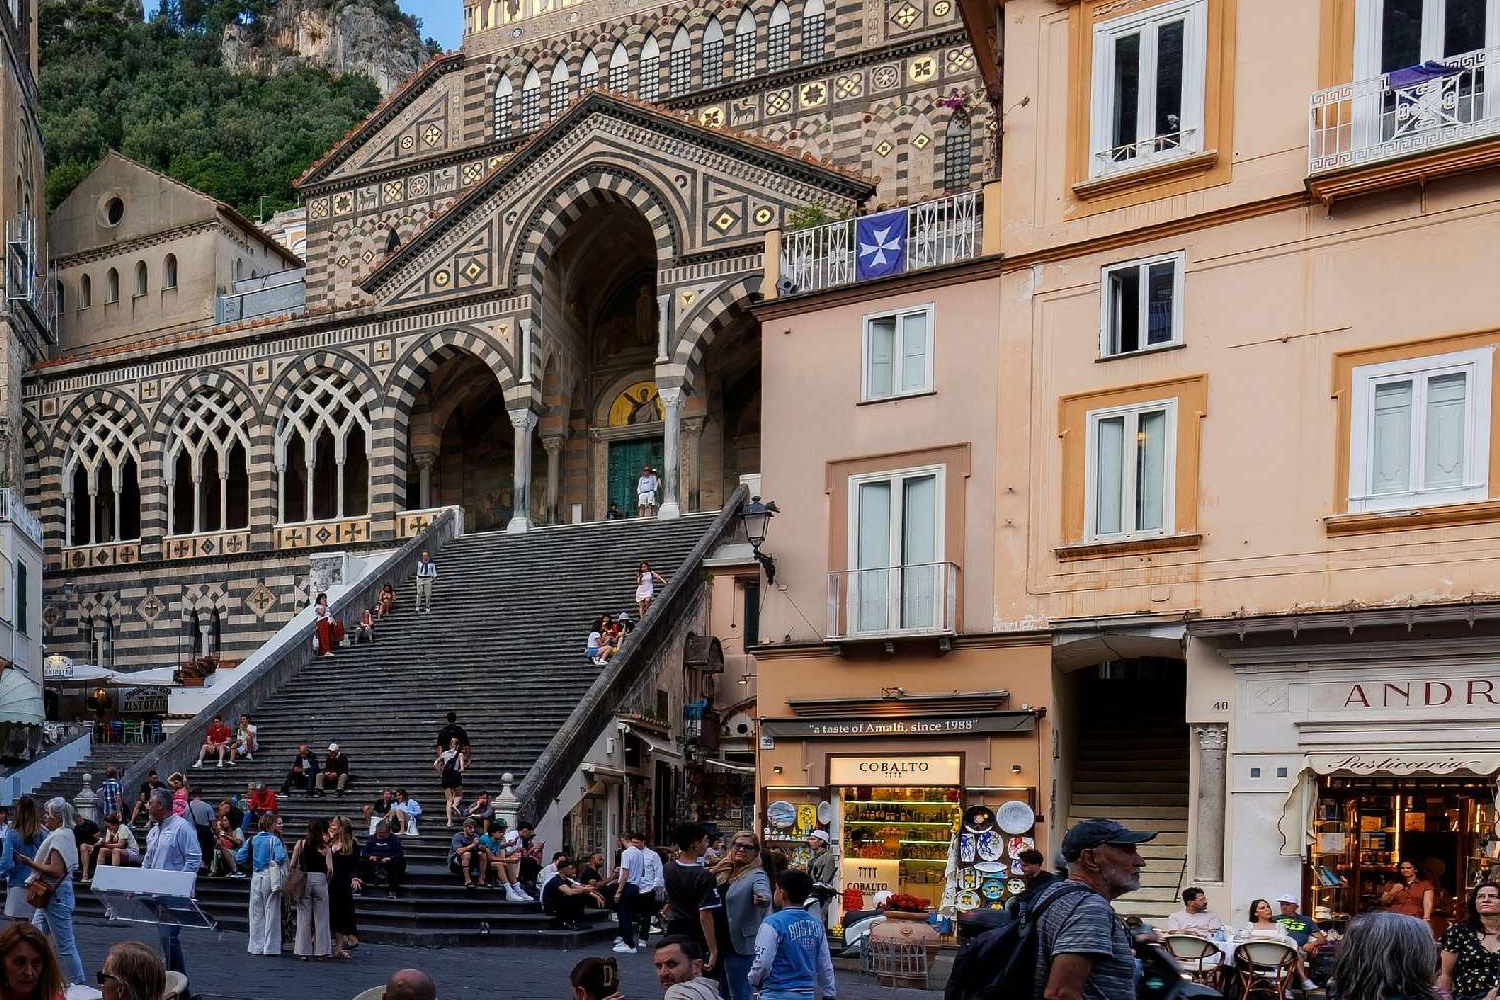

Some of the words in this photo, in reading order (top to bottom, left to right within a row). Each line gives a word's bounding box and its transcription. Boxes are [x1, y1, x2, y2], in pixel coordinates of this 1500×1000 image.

[1212, 700, 1229, 711] 40
[822, 724, 849, 734] taste
[851, 723, 864, 733] of
[866, 722, 909, 734] Amalfi,
[910, 721, 942, 732] since
[859, 762, 930, 773] COBALTO
[846, 882, 888, 891] COBALTO
